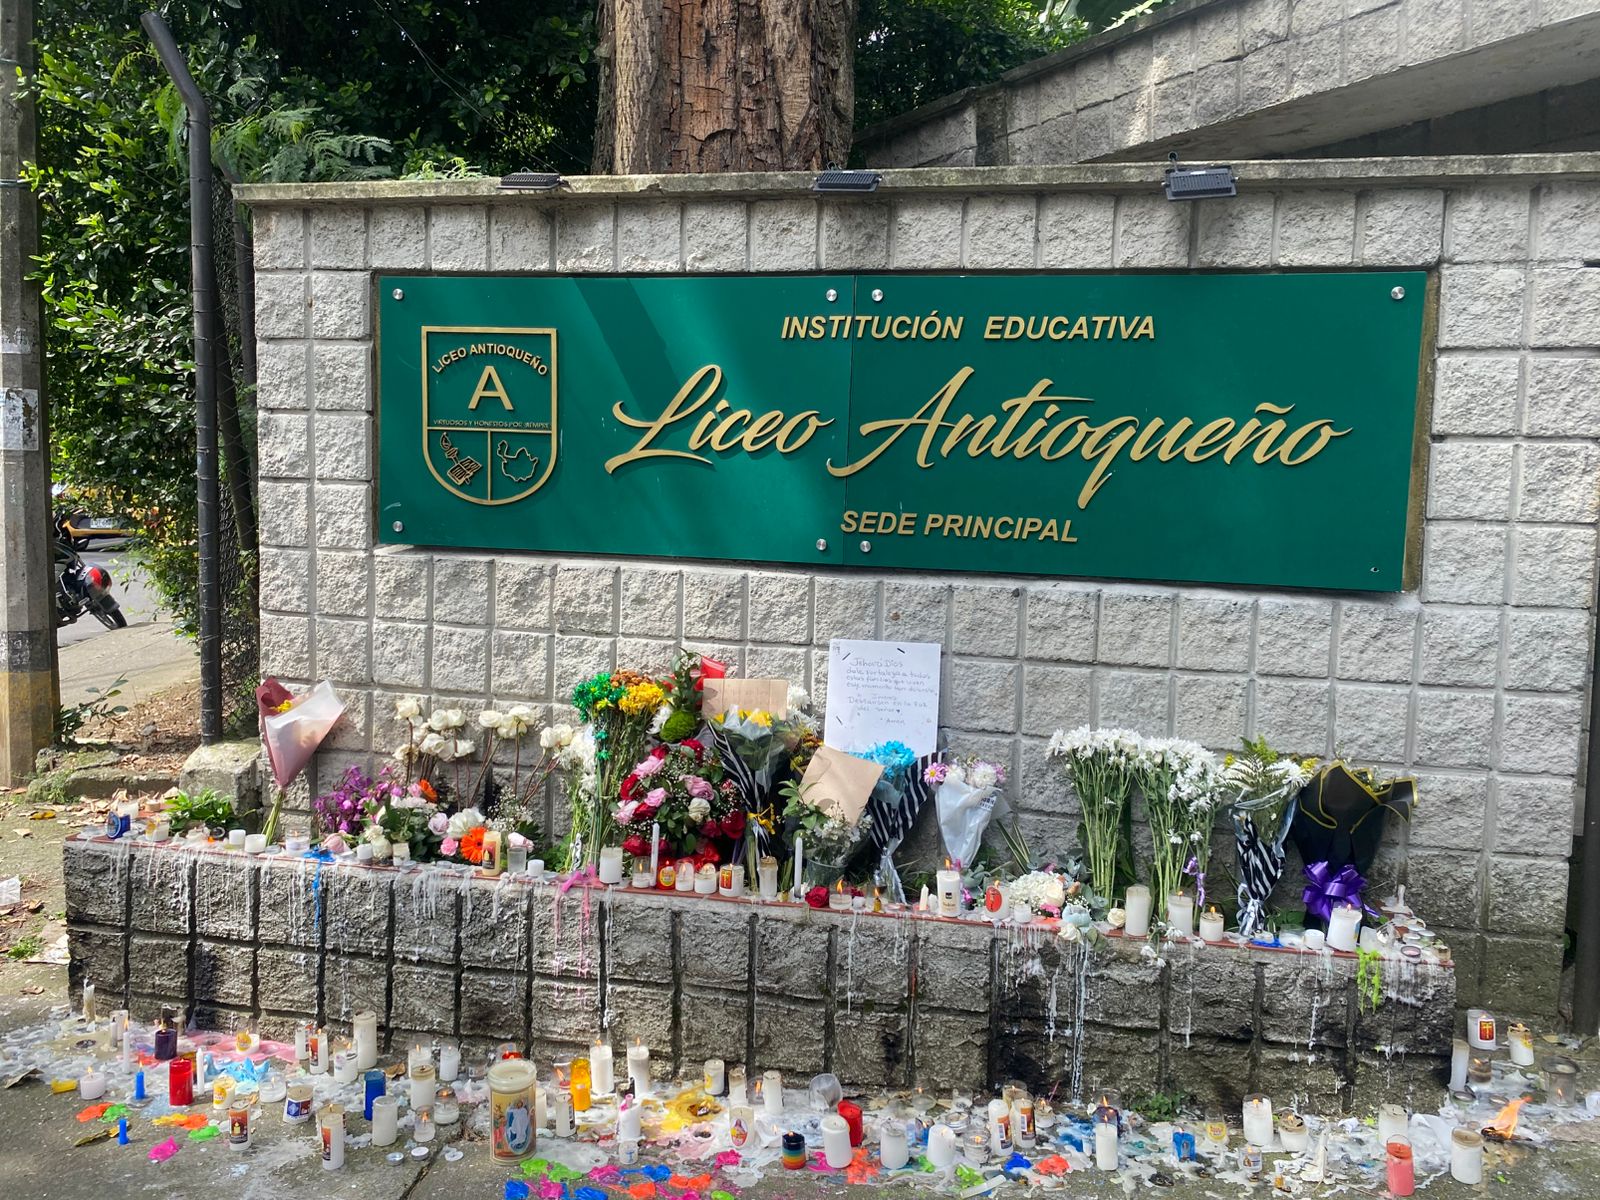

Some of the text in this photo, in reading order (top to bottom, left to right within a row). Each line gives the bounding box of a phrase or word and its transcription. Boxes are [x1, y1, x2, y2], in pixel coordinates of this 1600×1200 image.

[780, 310, 1156, 341] INSTITUCIÓN EDUCATIVA
[431, 343, 549, 376] LICEO ANTIOQUEÑO
[467, 364, 515, 411] A
[603, 363, 1354, 511] Liceo Antioqueño
[840, 510, 1079, 543] SEDE PRINCIPAL
